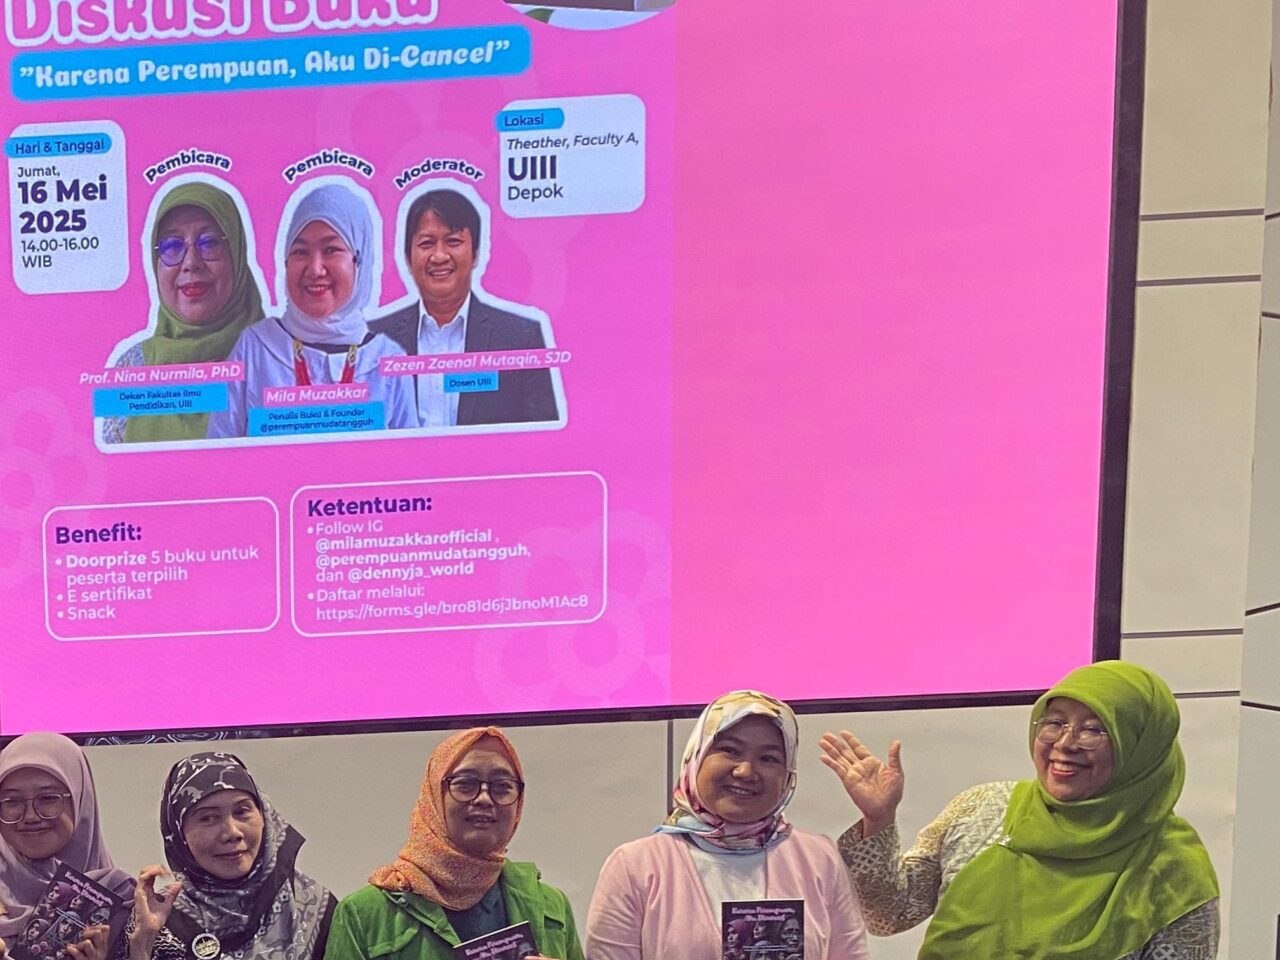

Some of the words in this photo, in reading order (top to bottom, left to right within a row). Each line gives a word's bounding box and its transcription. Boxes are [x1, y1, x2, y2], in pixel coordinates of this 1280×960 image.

[138, 57, 297, 84] Perempuan,
[304, 50, 355, 74] Aku
[504, 113, 545, 127] Lokasi
[15, 141, 41, 154] Hari
[44, 141, 53, 153] &
[56, 137, 105, 155] Tanggal
[506, 137, 571, 151] Theather,
[573, 133, 624, 148] Faculty
[626, 132, 640, 146] A,
[17, 165, 61, 178] Jumat,
[145, 150, 231, 182] Pembicara
[284, 149, 373, 181] Pembicara
[395, 159, 483, 188] Moderator
[507, 154, 558, 182] UIII
[17, 180, 48, 204] 16
[56, 173, 108, 203] Mei
[507, 183, 564, 202] Depok
[19, 208, 87, 234] 2025
[21, 236, 100, 252] 14.00-16.00
[21, 255, 53, 268] WIB
[383, 360, 425, 373] Zezen
[428, 356, 476, 370] Zaenal
[480, 352, 542, 368] Mutaqin,
[544, 351, 572, 364] SJD
[79, 370, 111, 385] Prof.
[114, 368, 146, 383] Nina
[150, 366, 208, 381] Nurmila,
[211, 364, 241, 378] PhD
[449, 379, 476, 388] Dosen
[266, 389, 296, 403] Mila
[299, 386, 369, 402] Muzakkar
[308, 496, 433, 517] Ketentuan:
[55, 522, 142, 545] Benefit:
[316, 520, 364, 536] Follow
[368, 519, 384, 533] IG
[65, 551, 147, 570] Doorprize
[150, 550, 160, 564] 5
[164, 547, 206, 564] buku
[210, 545, 260, 562] untuk
[315, 543, 532, 568] @perempuanmudatangguh,
[66, 570, 126, 588] peserta
[130, 565, 188, 584] terpilih
[316, 568, 344, 583] dan
[348, 562, 475, 583] @dennyja_world
[66, 589, 77, 603] E
[80, 585, 153, 603] sertifikat
[316, 587, 363, 602] Daftar
[367, 584, 425, 600] melalui:
[66, 604, 116, 620] Snack
